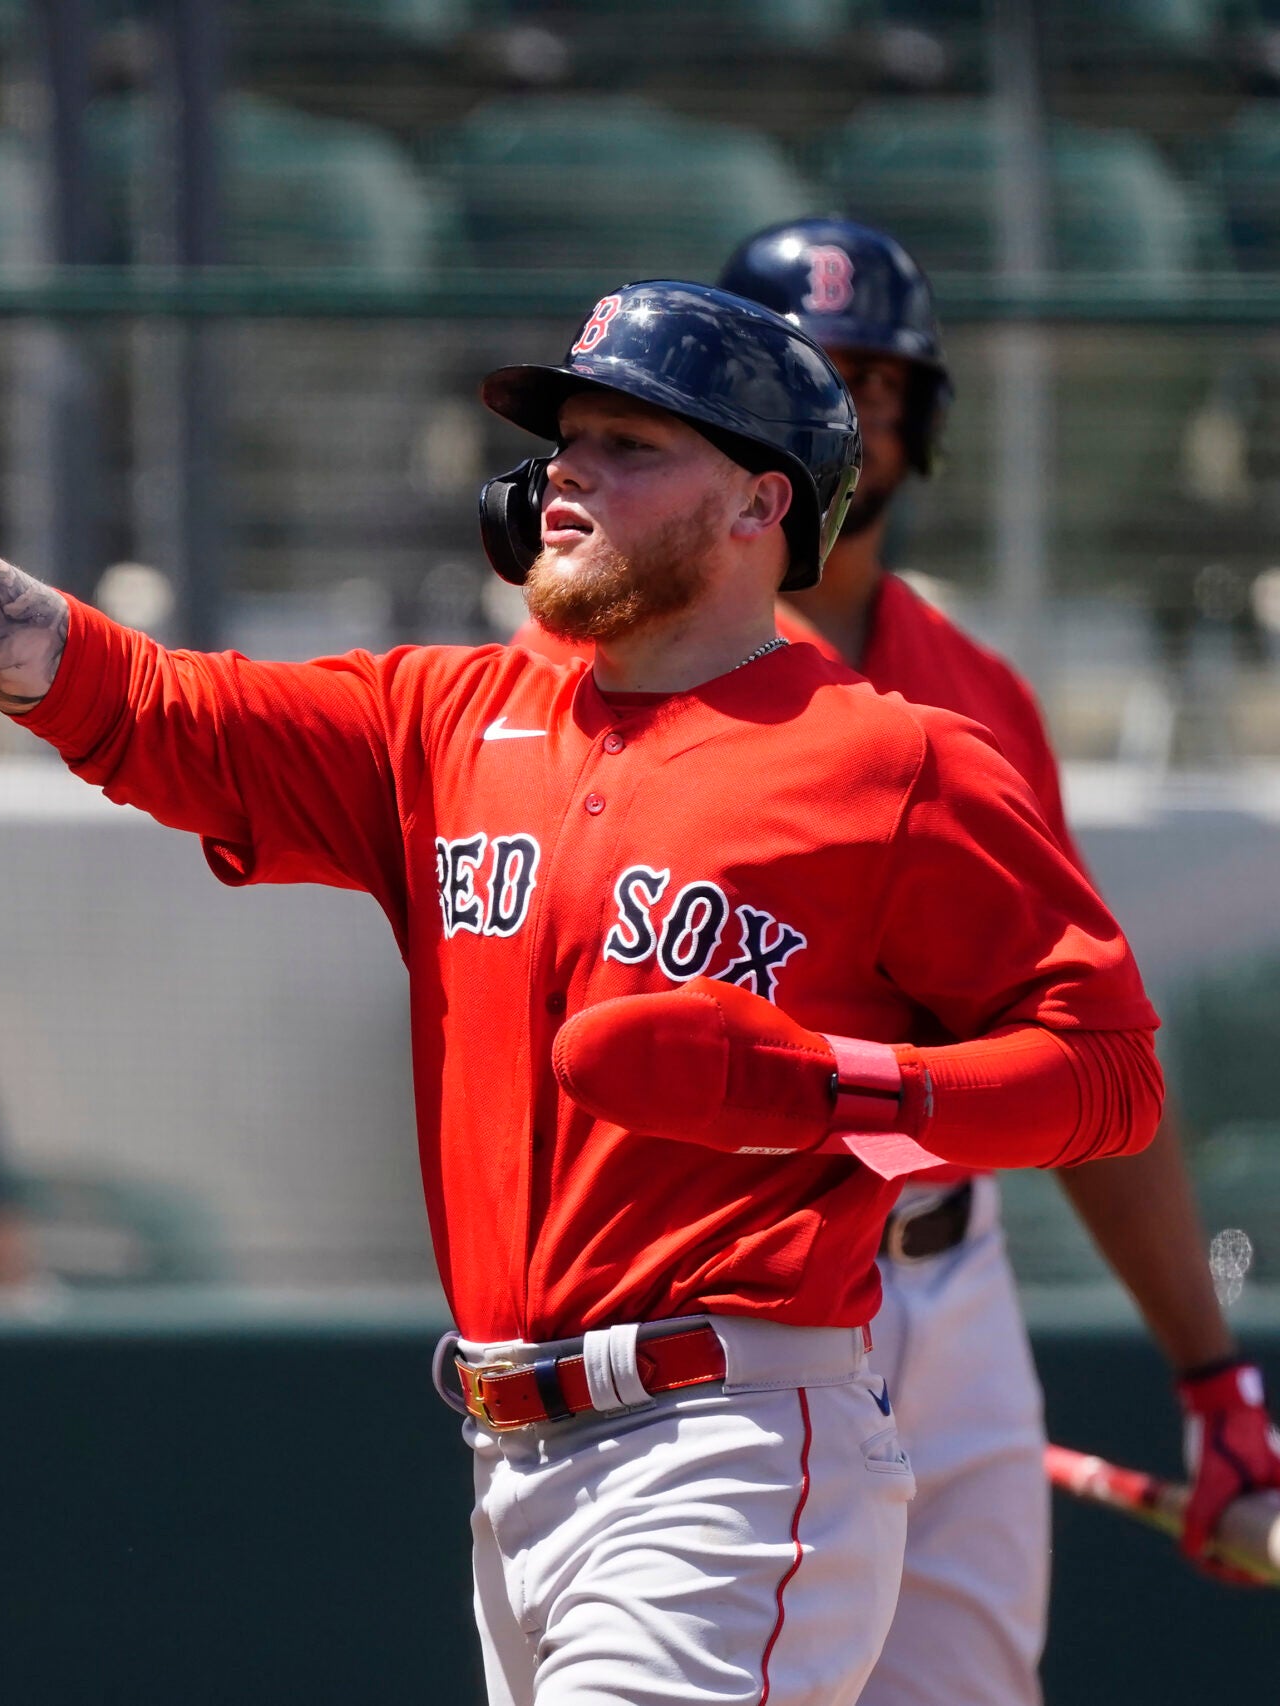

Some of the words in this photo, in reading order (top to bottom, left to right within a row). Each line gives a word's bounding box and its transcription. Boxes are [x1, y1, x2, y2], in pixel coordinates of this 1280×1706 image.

[801, 245, 855, 314] B
[572, 294, 622, 356] B
[603, 864, 808, 1005] SOX
